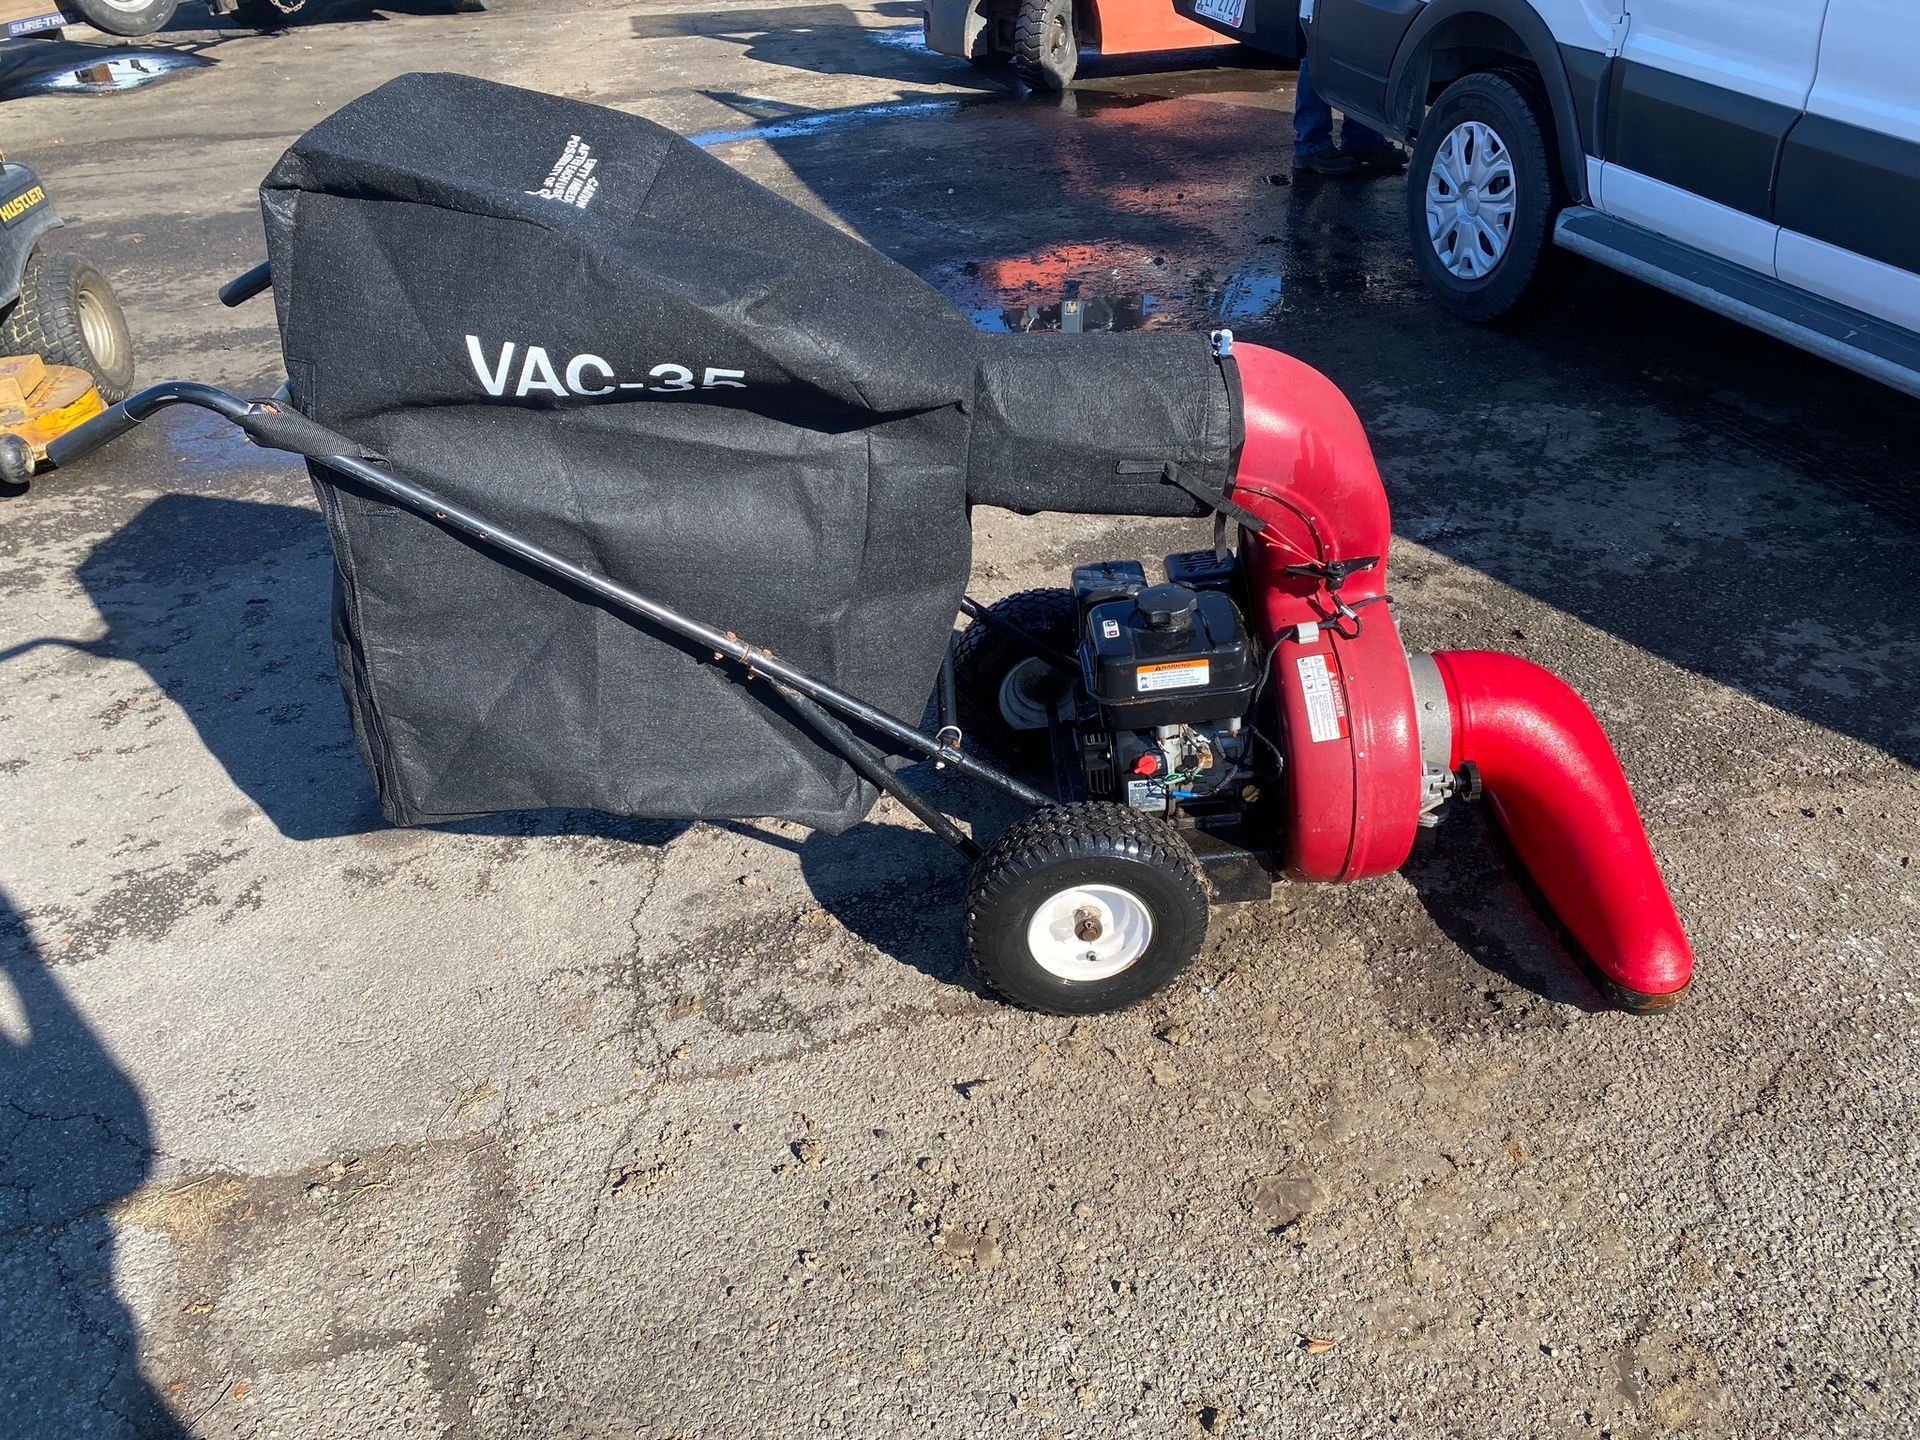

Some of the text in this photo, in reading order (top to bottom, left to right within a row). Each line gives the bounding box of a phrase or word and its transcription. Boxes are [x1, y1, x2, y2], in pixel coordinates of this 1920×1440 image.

[11, 15, 66, 34] SURE-TRA
[0, 185, 46, 222] HUSTLER
[563, 177, 585, 204] IMMED
[465, 334, 748, 397] VAC-35
[1160, 662, 1191, 671] WARNING
[1330, 680, 1345, 718] DANGER
